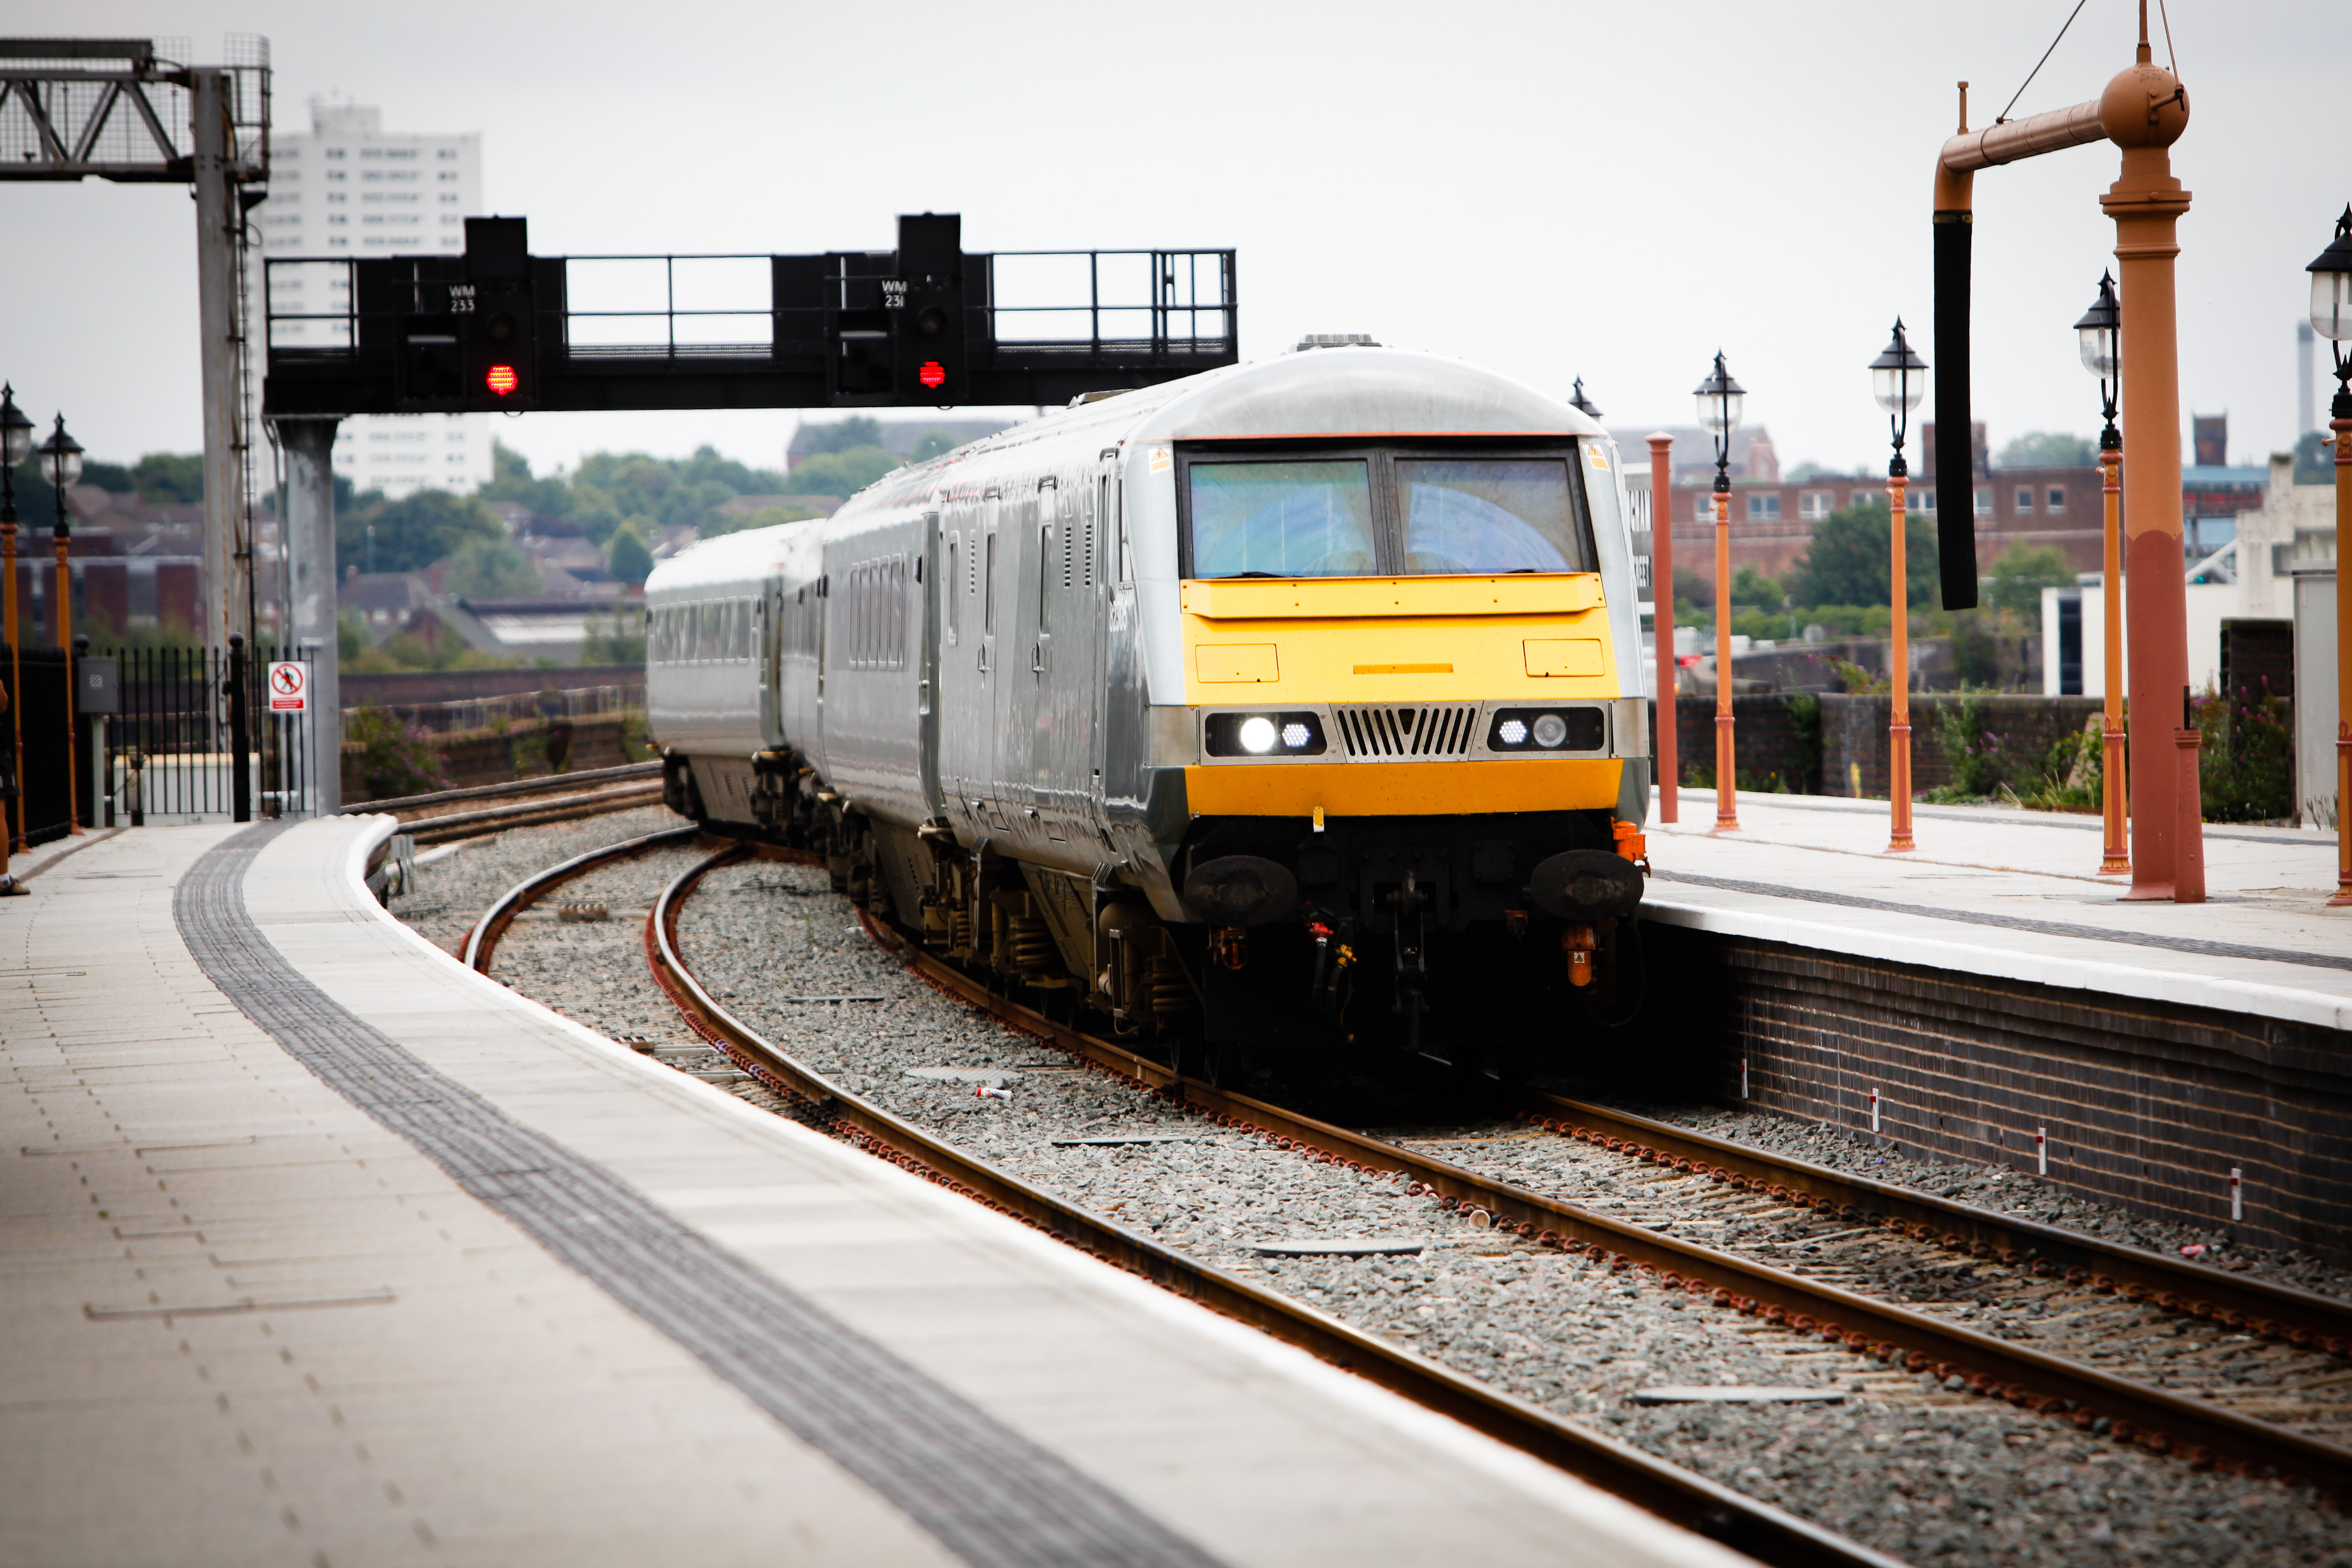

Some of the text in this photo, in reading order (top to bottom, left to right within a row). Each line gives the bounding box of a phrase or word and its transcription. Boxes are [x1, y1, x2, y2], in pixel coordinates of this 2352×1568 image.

[449, 284, 476, 297] WM
[881, 280, 907, 293] WM
[450, 299, 476, 312] 233
[885, 295, 905, 308] 231
